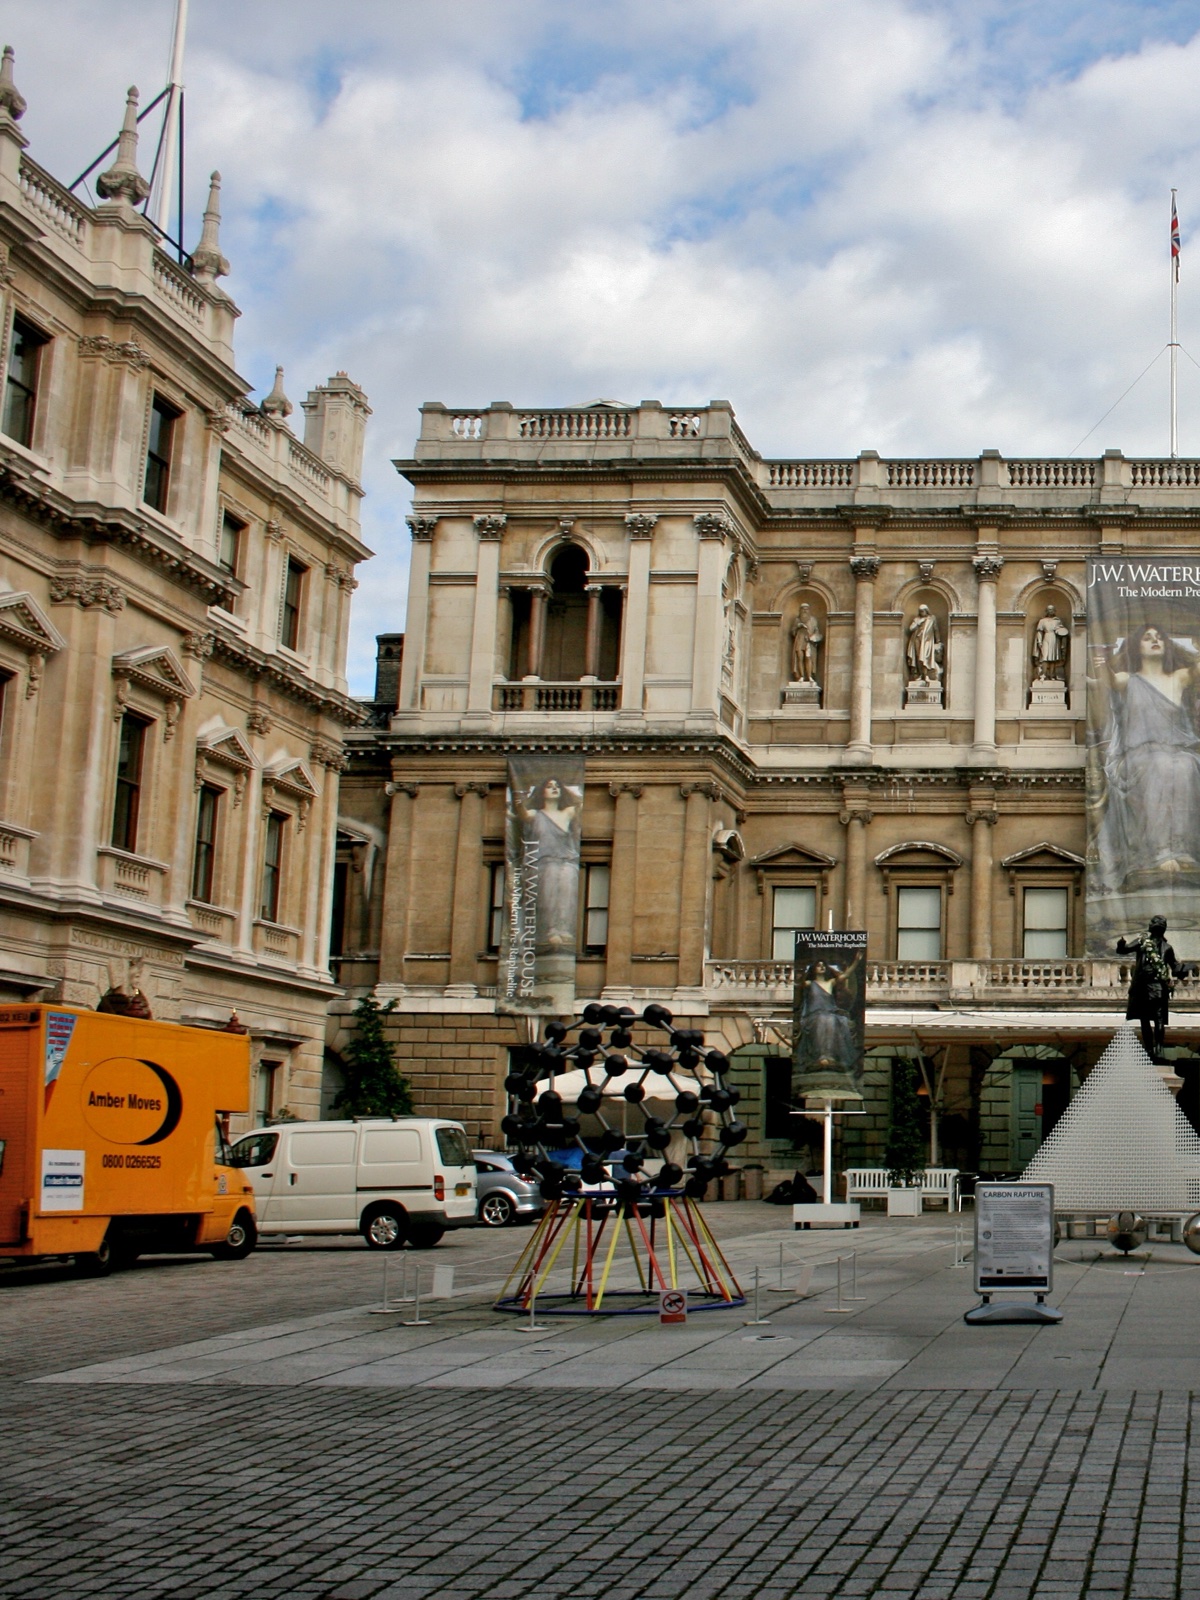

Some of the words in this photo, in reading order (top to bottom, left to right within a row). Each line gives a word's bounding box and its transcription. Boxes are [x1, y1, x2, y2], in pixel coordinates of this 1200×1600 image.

[1088, 565, 1125, 588] J.W.
[1118, 587, 1139, 598] The
[1140, 587, 1183, 598] Modern
[521, 838, 540, 871] J.W.
[511, 886, 523, 925] Modern
[519, 875, 539, 997] WATERHOUSE
[797, 933, 811, 944] J.W.
[813, 933, 866, 942] WATERHOUSE
[506, 926, 521, 998] Pre-Raphaelite
[88, 1090, 125, 1109] Amber
[128, 1093, 161, 1111] Moves
[102, 1154, 124, 1168] 0800
[125, 1154, 161, 1168] 0266525
[983, 1191, 1012, 1199] CARBON
[1013, 1191, 1044, 1199] RAPTURE
